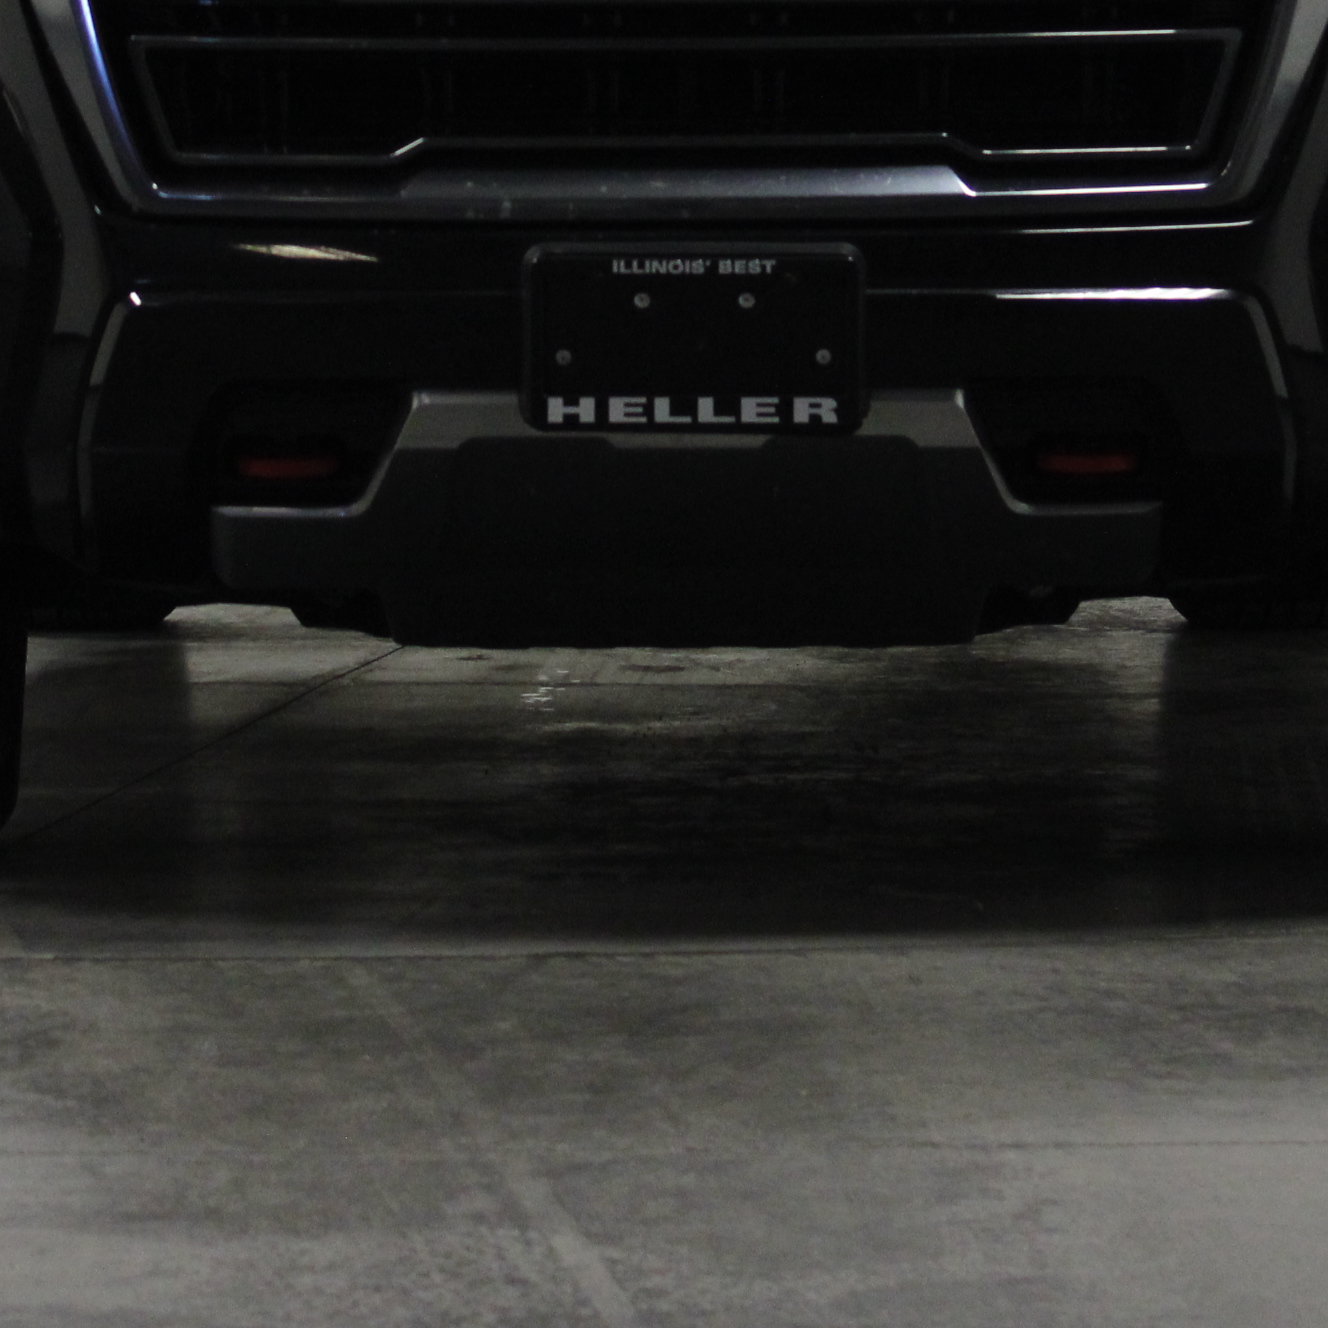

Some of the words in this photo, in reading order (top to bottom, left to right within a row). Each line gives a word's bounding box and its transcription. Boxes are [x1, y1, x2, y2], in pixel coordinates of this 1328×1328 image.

[612, 258, 711, 274] ILLINOIS'
[718, 258, 776, 274] BEST
[547, 397, 838, 423] HELLER
